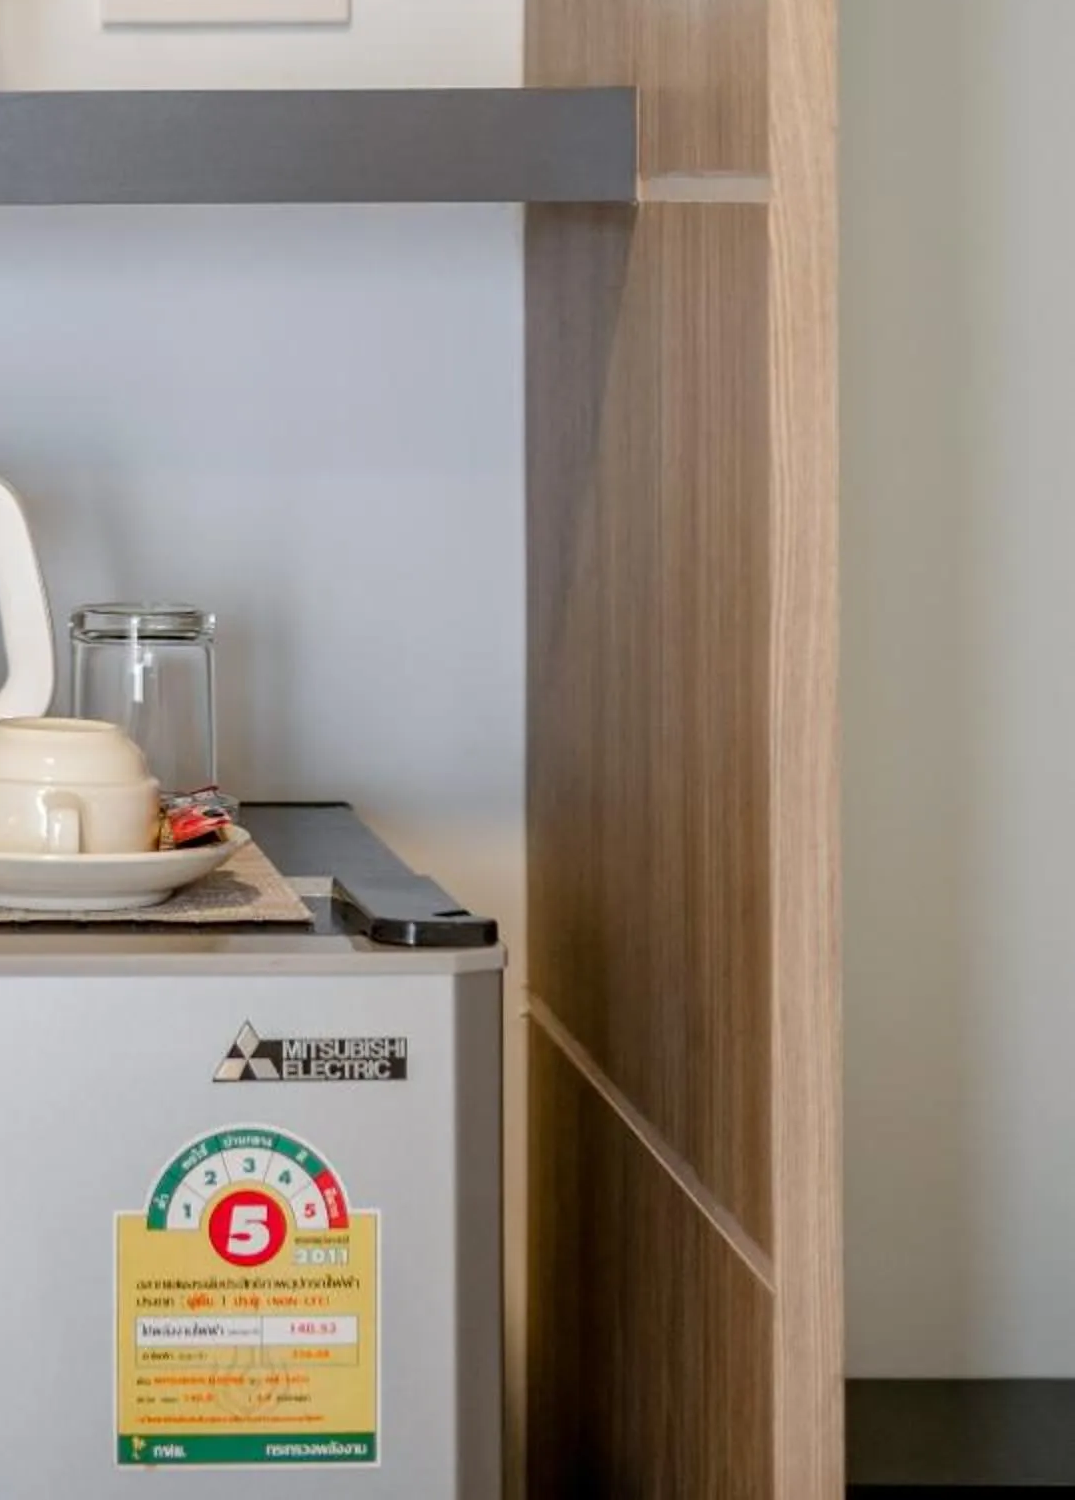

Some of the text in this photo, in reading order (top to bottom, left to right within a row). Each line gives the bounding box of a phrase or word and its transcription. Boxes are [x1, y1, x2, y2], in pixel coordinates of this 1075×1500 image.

[282, 1039, 406, 1059] MITSUBISHI
[282, 1060, 391, 1079] ELECTRIC
[243, 1157, 256, 1173] 3
[204, 1170, 218, 1186] 2
[278, 1169, 292, 1186] 4
[182, 1202, 192, 1219] 1
[304, 1203, 316, 1219] 5
[226, 1204, 271, 1257] 5
[295, 1247, 349, 1266] 2011
